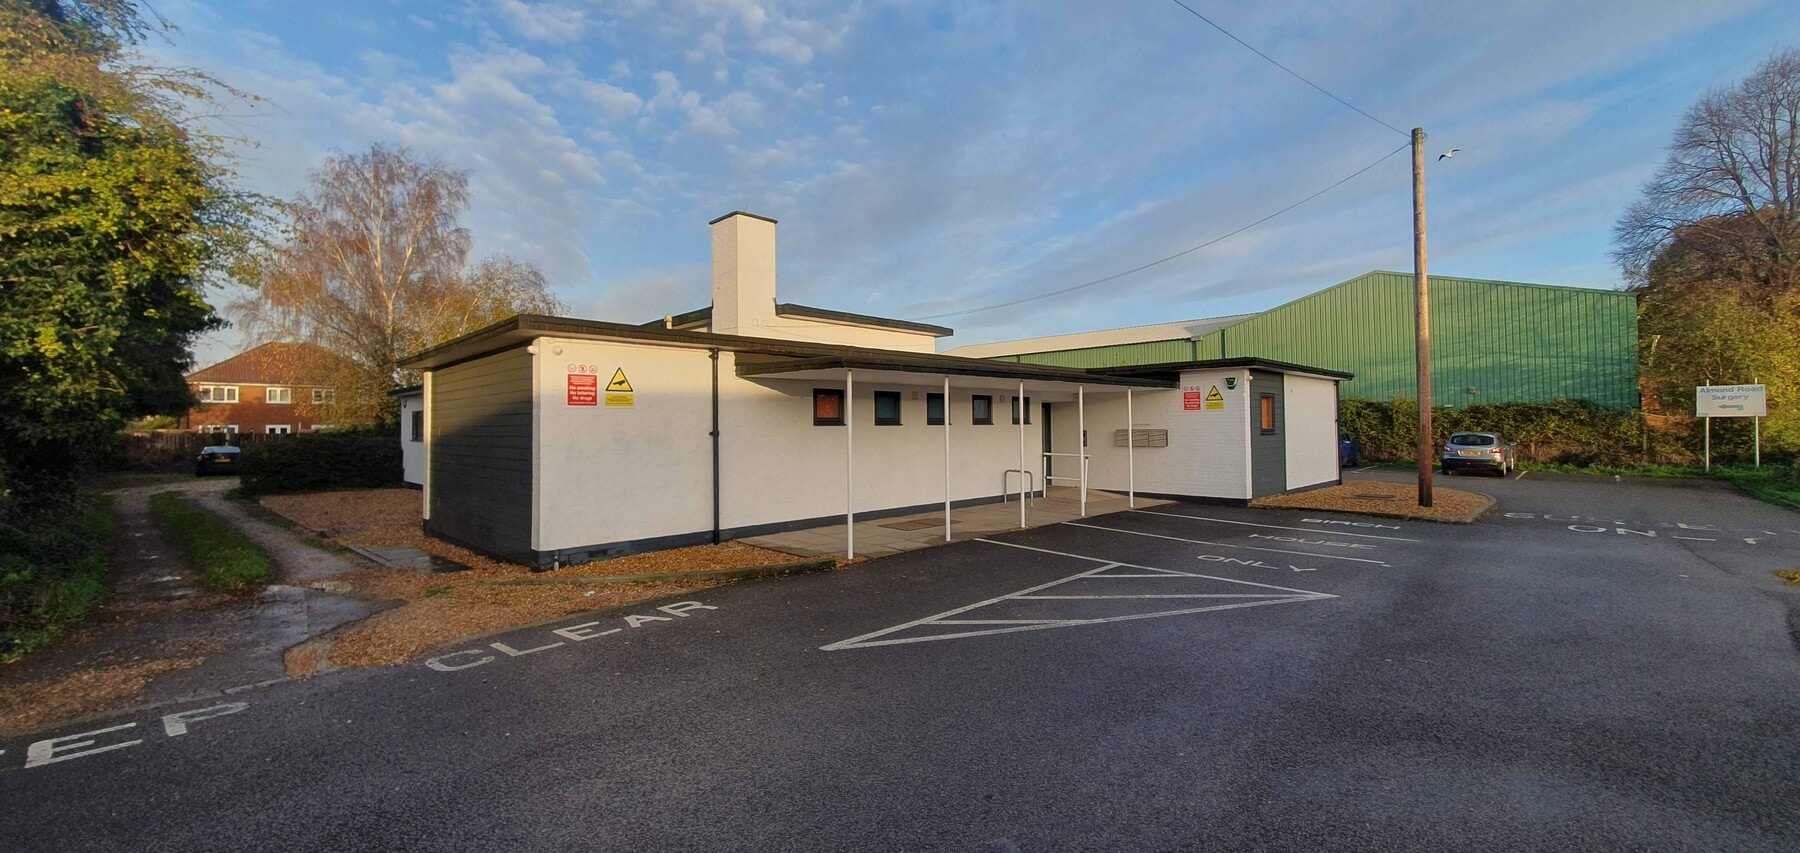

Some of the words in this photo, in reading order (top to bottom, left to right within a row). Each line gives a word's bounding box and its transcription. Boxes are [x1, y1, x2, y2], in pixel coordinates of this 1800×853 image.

[1300, 518, 1400, 530] BIRCH
[1248, 533, 1378, 550] HOUSE
[1197, 554, 1317, 572] ONLY
[424, 600, 718, 672] CLEAR
